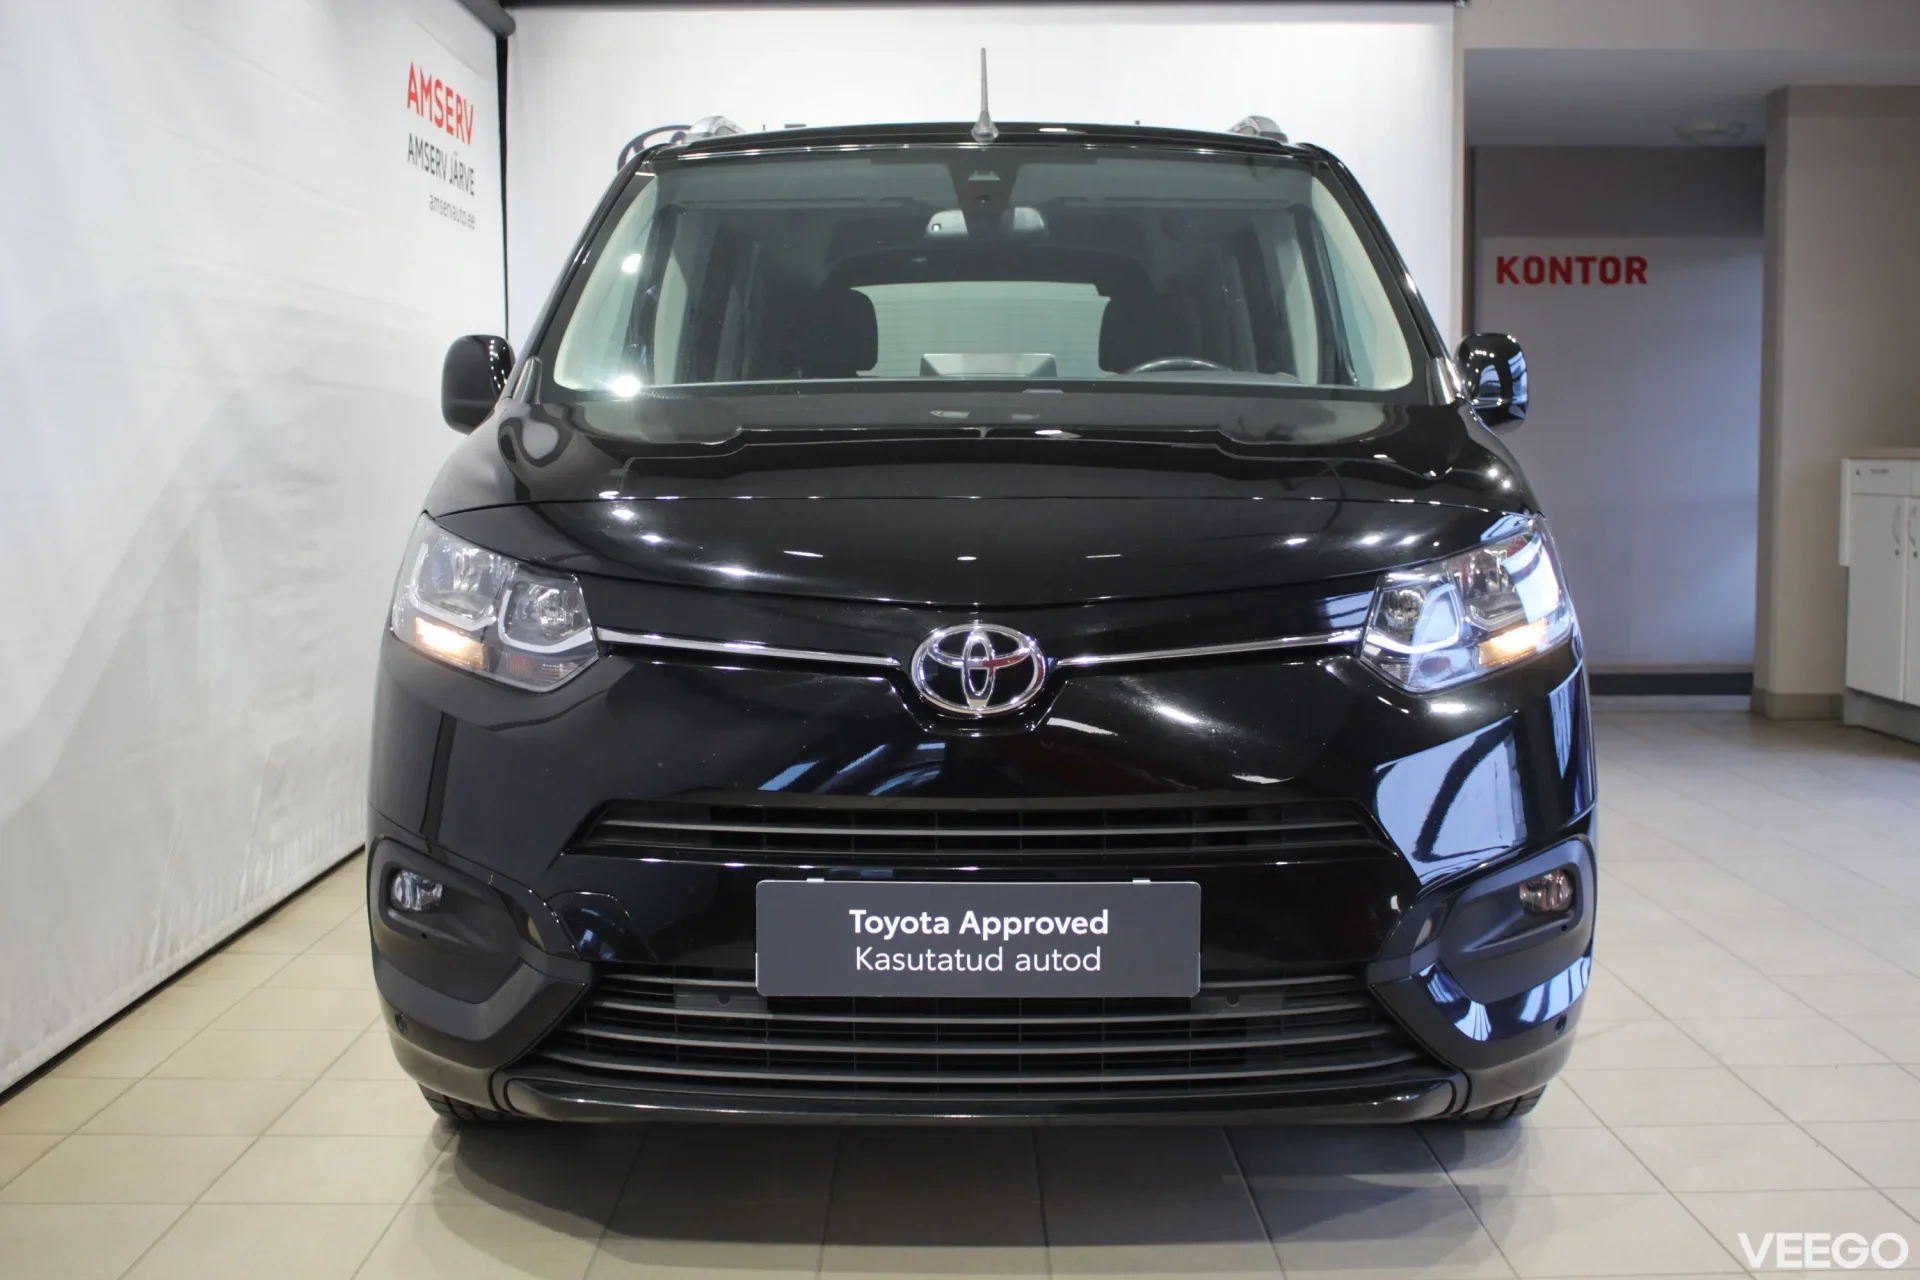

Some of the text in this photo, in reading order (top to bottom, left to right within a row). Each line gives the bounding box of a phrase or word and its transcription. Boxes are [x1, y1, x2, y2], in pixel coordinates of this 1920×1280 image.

[407, 61, 474, 146] AMSERV
[407, 133, 475, 196] AMSERV JÄRVE
[1496, 255, 1649, 286] KONTOR
[849, 909, 1109, 941] Toyota Approved
[856, 946, 1101, 972] Kasutatud autod
